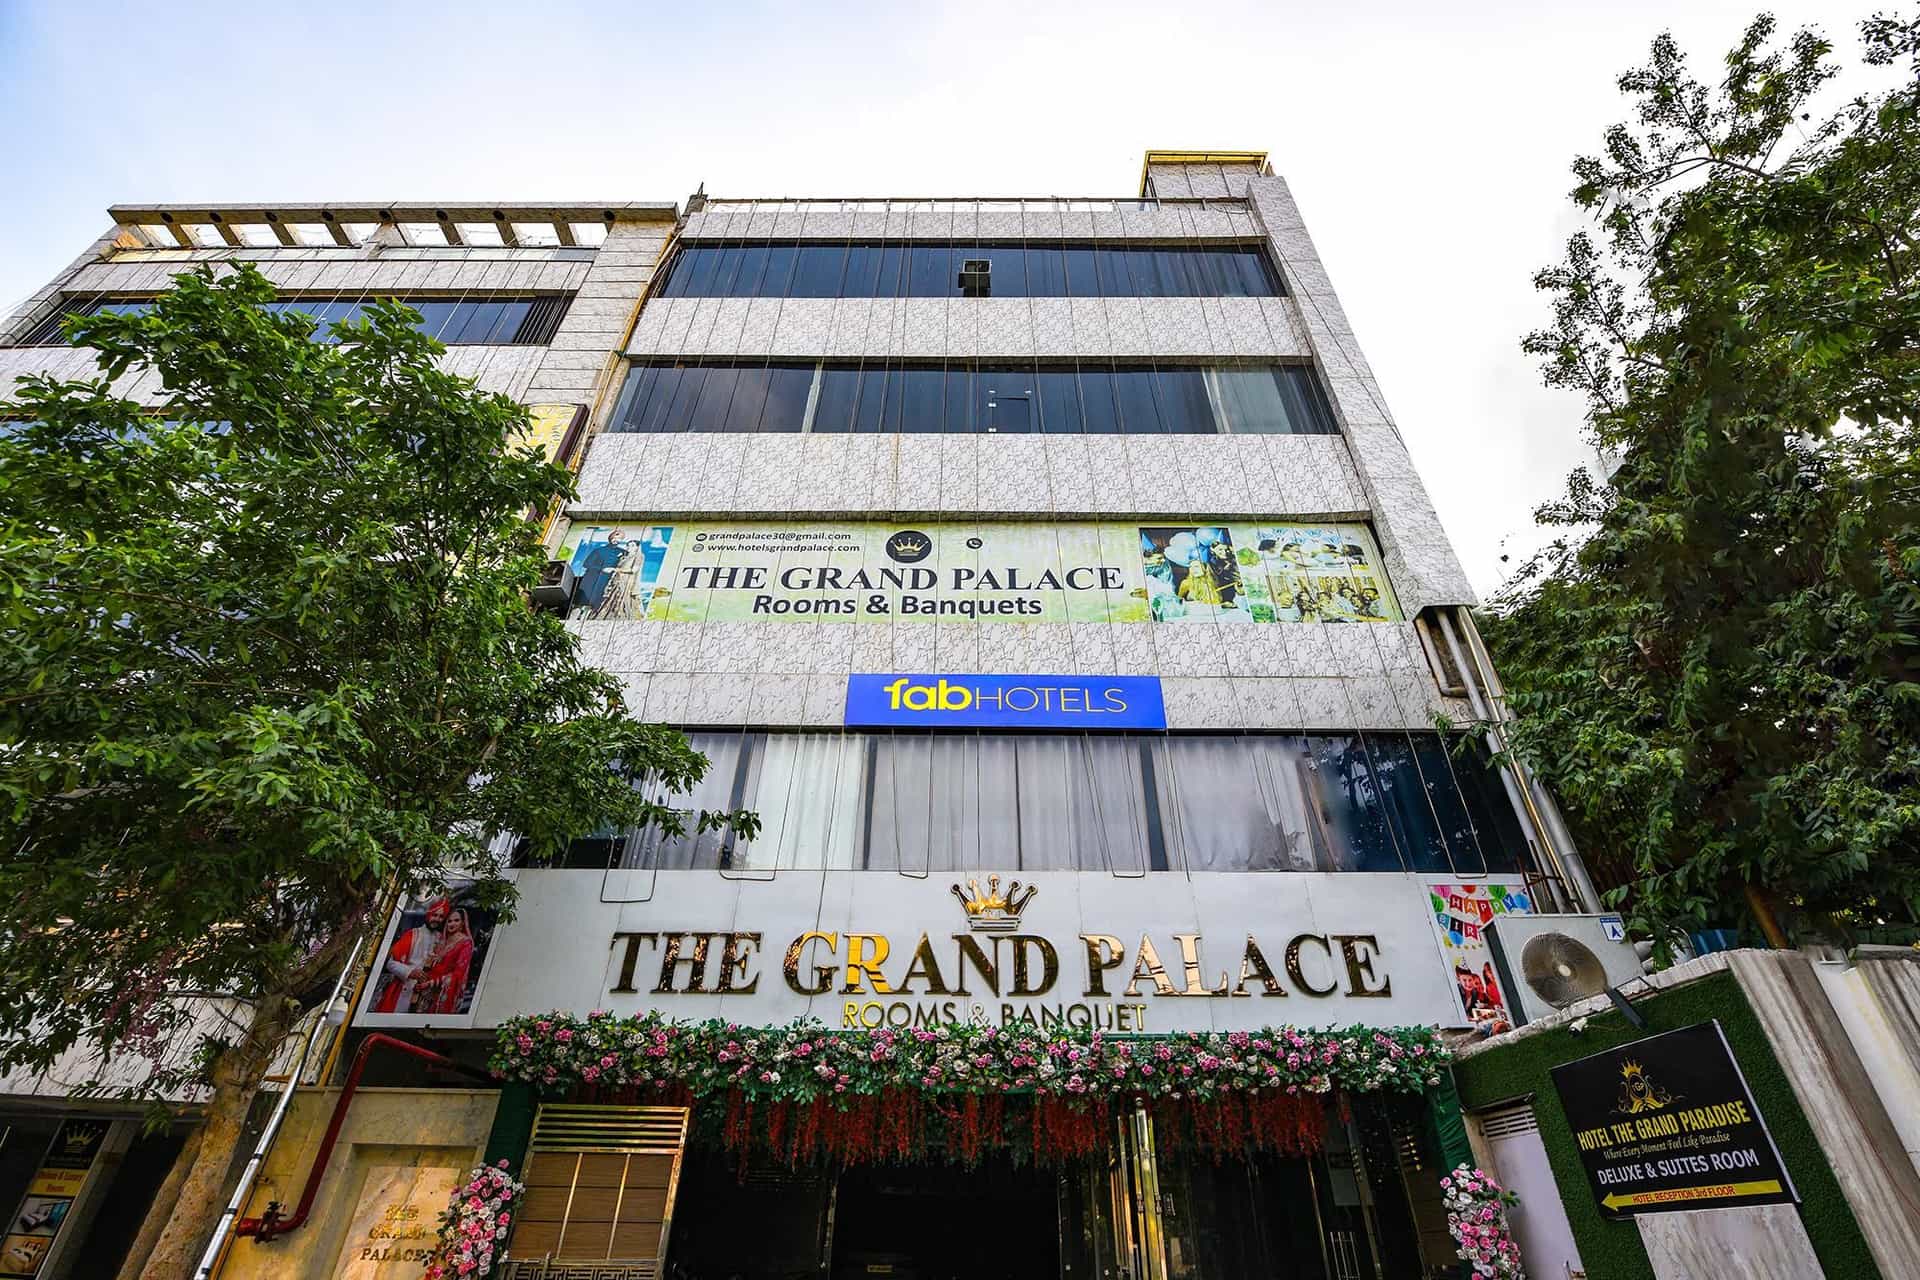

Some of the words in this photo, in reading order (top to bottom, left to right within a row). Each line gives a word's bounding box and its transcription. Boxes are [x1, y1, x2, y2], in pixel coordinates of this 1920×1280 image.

[707, 544, 860, 552] www.hotelsgrandpalace.com
[708, 532, 851, 541] grandpalace30@gmail.com
[682, 567, 768, 590] THE
[780, 566, 938, 590] GRAND
[952, 567, 1124, 591] PALACE
[753, 595, 856, 614] Rooms
[865, 594, 891, 614] &
[901, 596, 1042, 619] Banquets
[1451, 894, 1514, 914] HAPPY
[608, 931, 763, 995] THE
[783, 931, 1060, 997] GRAND
[1079, 932, 1393, 998] PALACE
[842, 1001, 956, 1030] ROOMS
[968, 1002, 992, 1028] &
[1000, 1003, 1147, 1031] BANQUET
[1577, 1128, 1614, 1151] HOTEL
[1611, 1120, 1637, 1143] THE
[1635, 1113, 1680, 1139] GRAND
[1678, 1100, 1751, 1132] PARADISE
[1699, 1130, 1731, 1145] Paradise
[1597, 1164, 1645, 1185] DELUXE
[1645, 1163, 1659, 1179] &
[1658, 1155, 1710, 1177] SUITES
[1710, 1148, 1760, 1171] ROOM
[1632, 1193, 1654, 1203] HOTEL
[1654, 1190, 1695, 1201] RECEPTION
[1706, 1186, 1736, 1197] FLOOR
